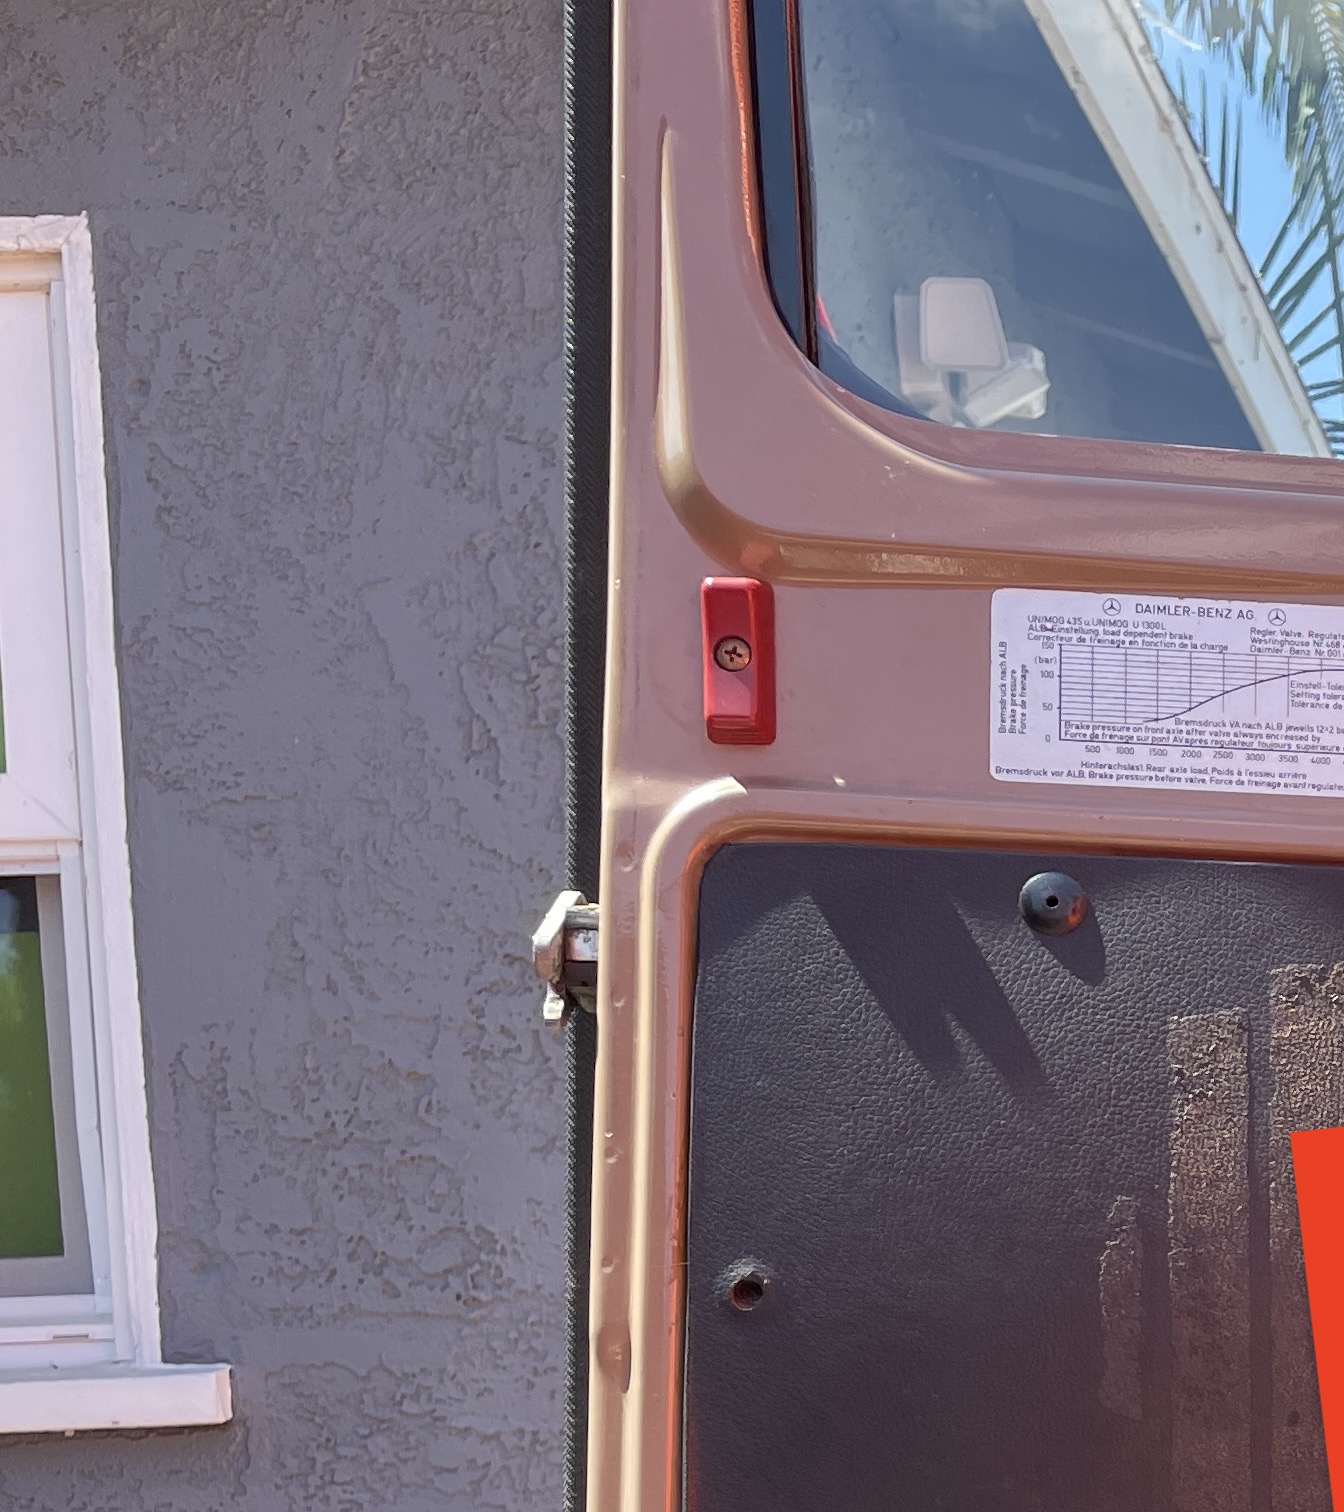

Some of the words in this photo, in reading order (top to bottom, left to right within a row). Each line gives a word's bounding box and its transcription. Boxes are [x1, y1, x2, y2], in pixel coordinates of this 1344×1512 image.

[1136, 603, 1233, 618] DAIMLER-BENZ
[1237, 606, 1255, 619] AG
[1028, 615, 1064, 624] UNIMOG
[1092, 619, 1129, 628] UNIMOG
[1123, 630, 1167, 639] dependent
[1169, 632, 1193, 640] brake
[1027, 633, 1073, 642] Correcteur
[1200, 643, 1228, 653] charge
[1034, 657, 1057, 665] (bar)
[1041, 670, 1054, 679] 100
[1043, 703, 1053, 711] 50
[1064, 721, 1090, 730] Brake
[1092, 723, 1130, 734] pressure
[1234, 731, 1264, 741] always
[1311, 734, 1321, 743] by
[1064, 730, 1087, 739] Force
[1085, 745, 1101, 754] 500
[1116, 746, 1135, 755] 1000
[1181, 749, 1202, 758] 2000
[1213, 751, 1233, 759] 2500
[1245, 752, 1265, 761] 3000
[1278, 754, 1299, 763] 3500
[1311, 756, 1331, 765] 4000
[1146, 764, 1166, 773] Rear
[995, 766, 1048, 777] Bremsdruck
[1089, 771, 1114, 781] Brake
[1116, 772, 1153, 782] pressure
[1209, 777, 1233, 786] Force
